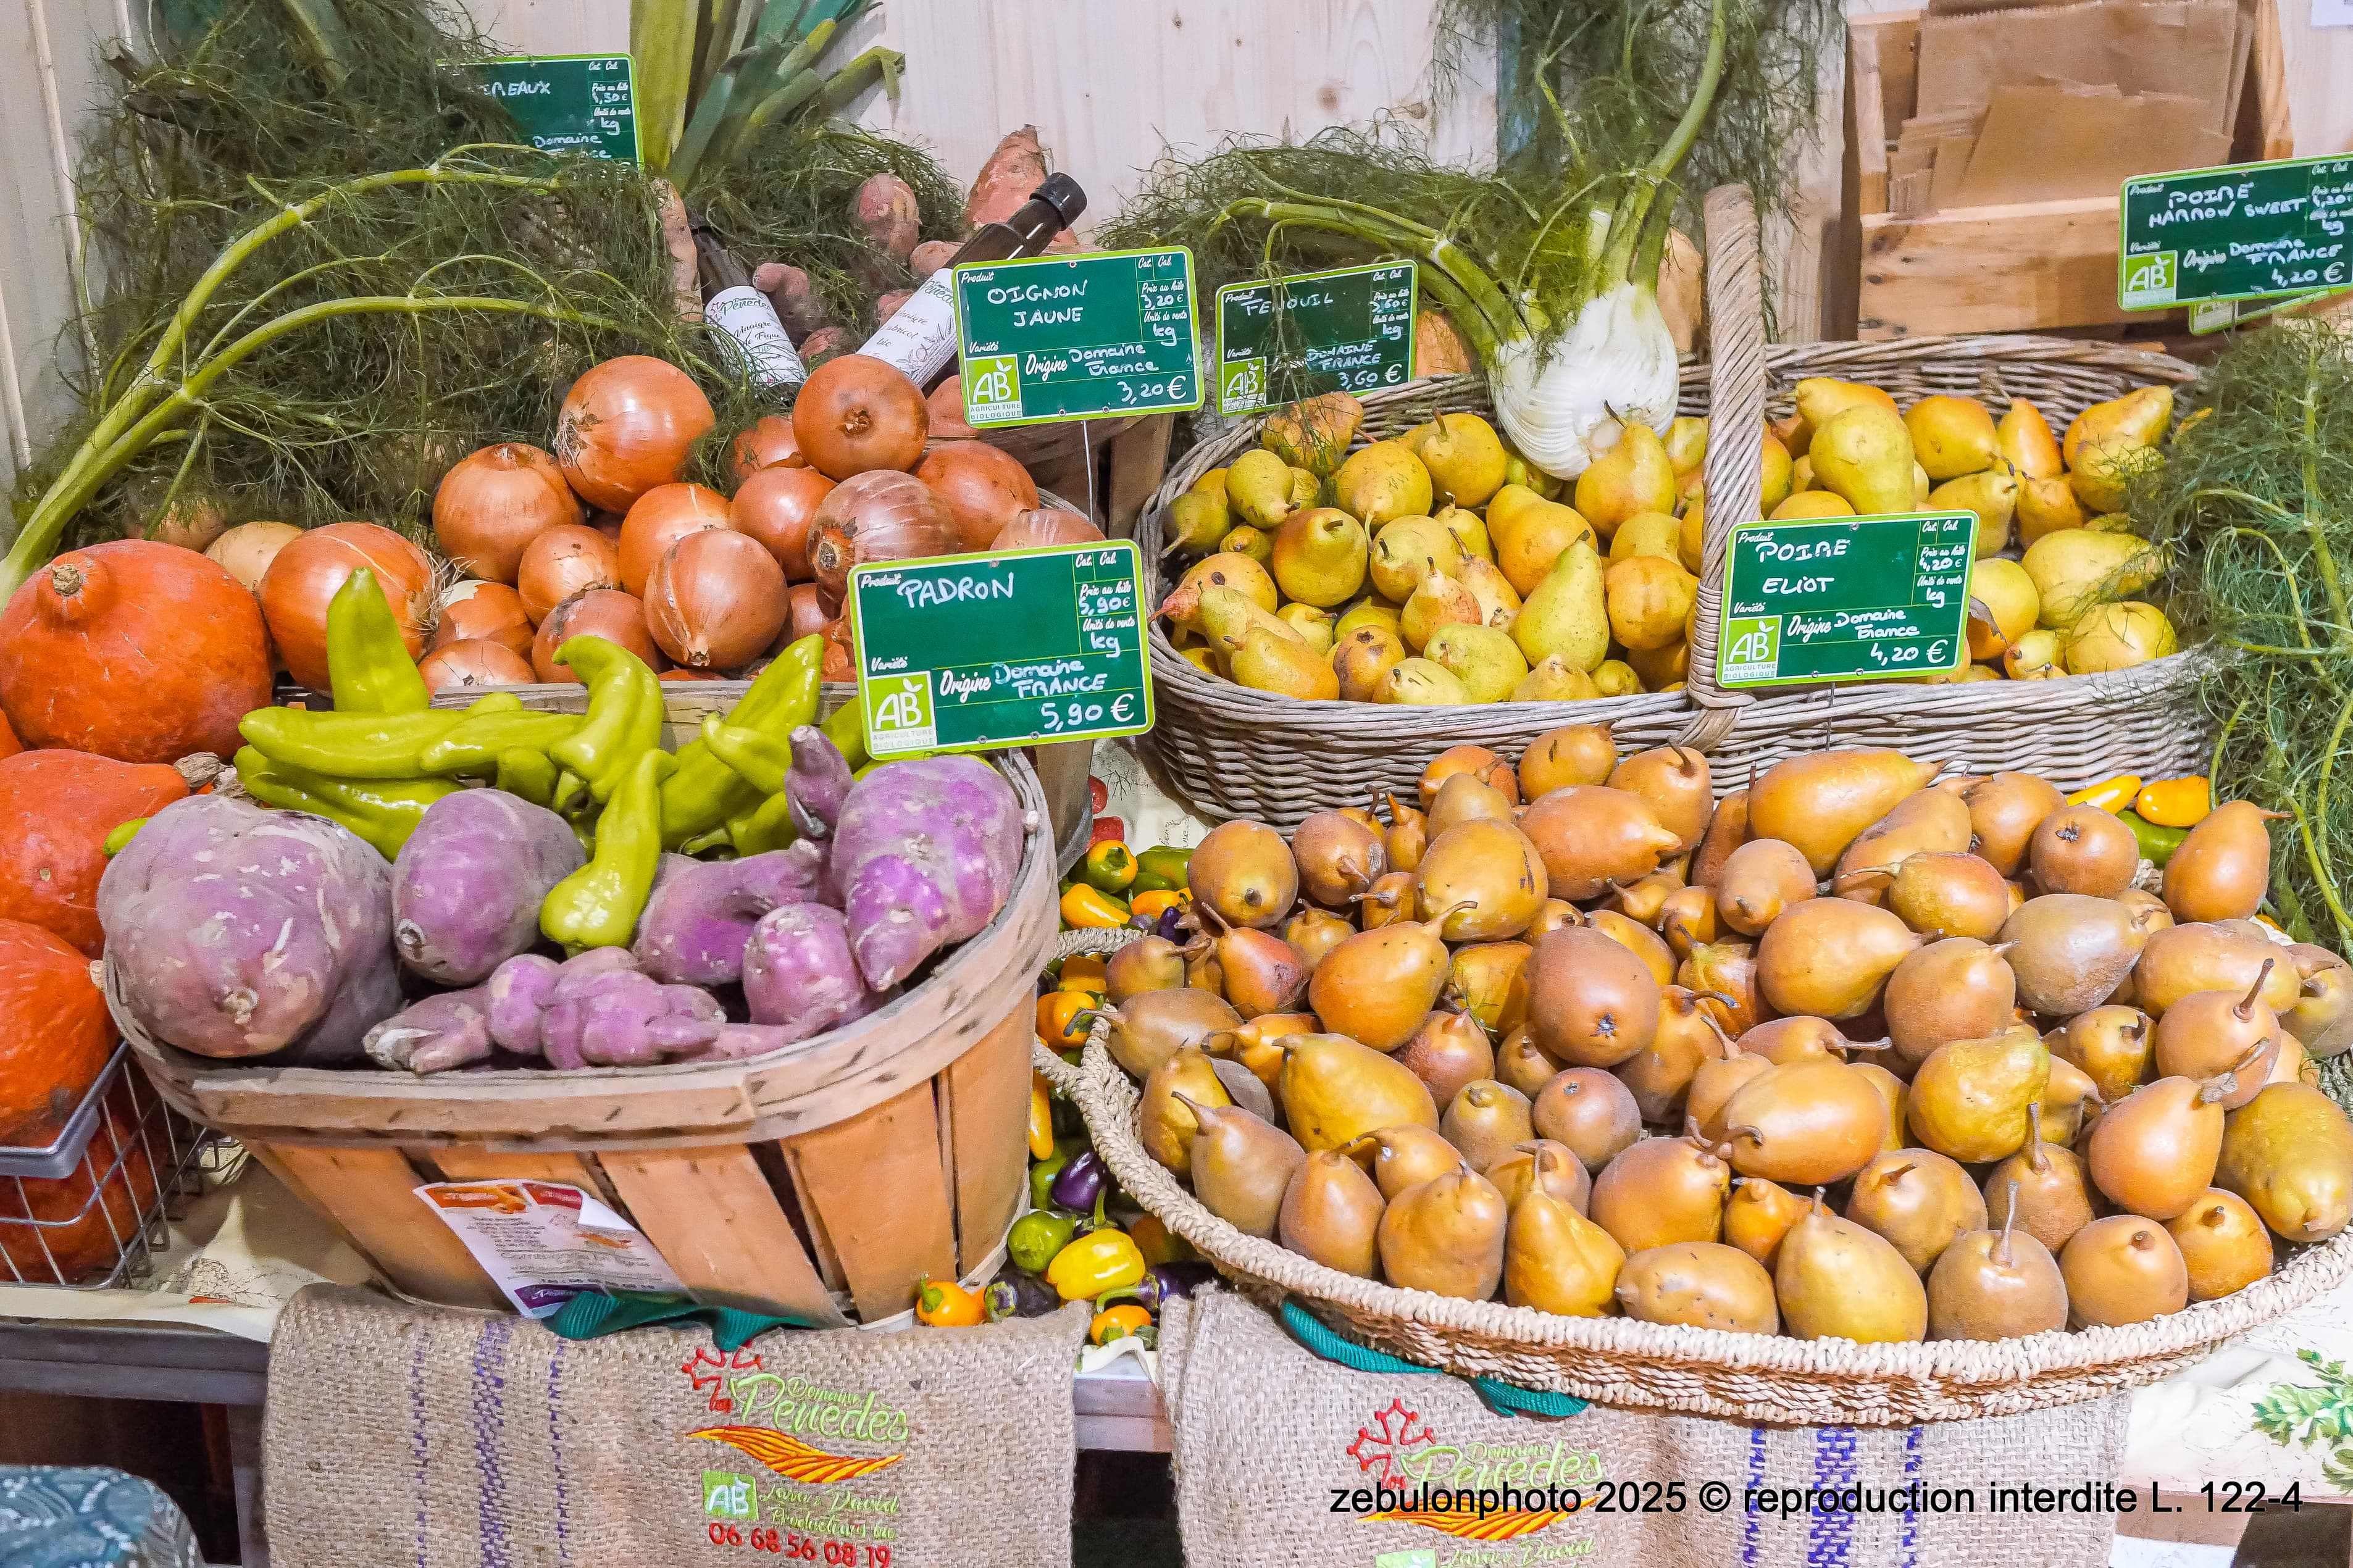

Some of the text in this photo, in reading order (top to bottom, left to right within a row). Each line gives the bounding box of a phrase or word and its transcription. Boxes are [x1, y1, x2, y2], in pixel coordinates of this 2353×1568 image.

[601, 117, 620, 135] kg
[533, 133, 603, 148] Domaine
[2169, 182, 2254, 209] POIRE
[2244, 198, 2308, 218] SWEET
[2322, 219, 2344, 236] kg
[2229, 238, 2305, 257] Domaine
[2128, 265, 2168, 292] AB
[2246, 244, 2344, 265] FRANCE
[2323, 262, 2345, 283] €
[961, 272, 995, 284] Produit
[1142, 283, 1158, 294] Prix
[1171, 280, 1184, 291] kilo
[987, 279, 1088, 305] OIGNON
[1140, 294, 1184, 311] 3,20 €
[1013, 307, 1084, 327] JAUNE
[1143, 310, 1187, 323] Unité de vente
[733, 322, 772, 338] Vinaigre
[755, 332, 781, 341] Figue
[1153, 323, 1177, 347] kg
[1382, 323, 1402, 341] kg
[969, 341, 999, 353] Variété
[1026, 344, 1147, 382] Origine Domaine
[1318, 354, 1381, 370] FRANCE
[972, 372, 1012, 404] AB
[1226, 371, 1258, 397] AB
[1384, 364, 1403, 383] €
[970, 403, 1021, 413] AGRICULTURE
[971, 411, 1022, 420] BIOLOGIQUE
[1737, 531, 1774, 544] Produit
[1755, 539, 1851, 564] POIRE
[1919, 557, 1963, 572] 4,20 €
[860, 572, 1014, 609] Produit PADRON
[1080, 580, 1132, 597] Prix au kilo
[1926, 587, 1945, 608] kg
[1734, 602, 1765, 614] Variété
[1082, 616, 1136, 632] Unité de vente
[1787, 609, 1907, 643] Origine Domaine
[1855, 623, 1920, 640] France
[1090, 632, 1121, 658] kg
[1728, 632, 1770, 663] AB
[1870, 639, 1949, 667] 4,20 €
[871, 657, 908, 671] Variété
[1724, 663, 1776, 672] AGRICULTURE
[939, 659, 1085, 704] Origine Domaine
[1723, 670, 1776, 679] BIOLOGIQUE
[1011, 673, 1108, 699] FRANCE
[875, 691, 1135, 732] AB 5,90 €
[872, 728, 934, 741] AGRICULTURE
[873, 737, 935, 749] BIOLOGIQUE
[708, 1483, 750, 1515] AB
[709, 1522, 892, 1568] 06 68 56 08 19
